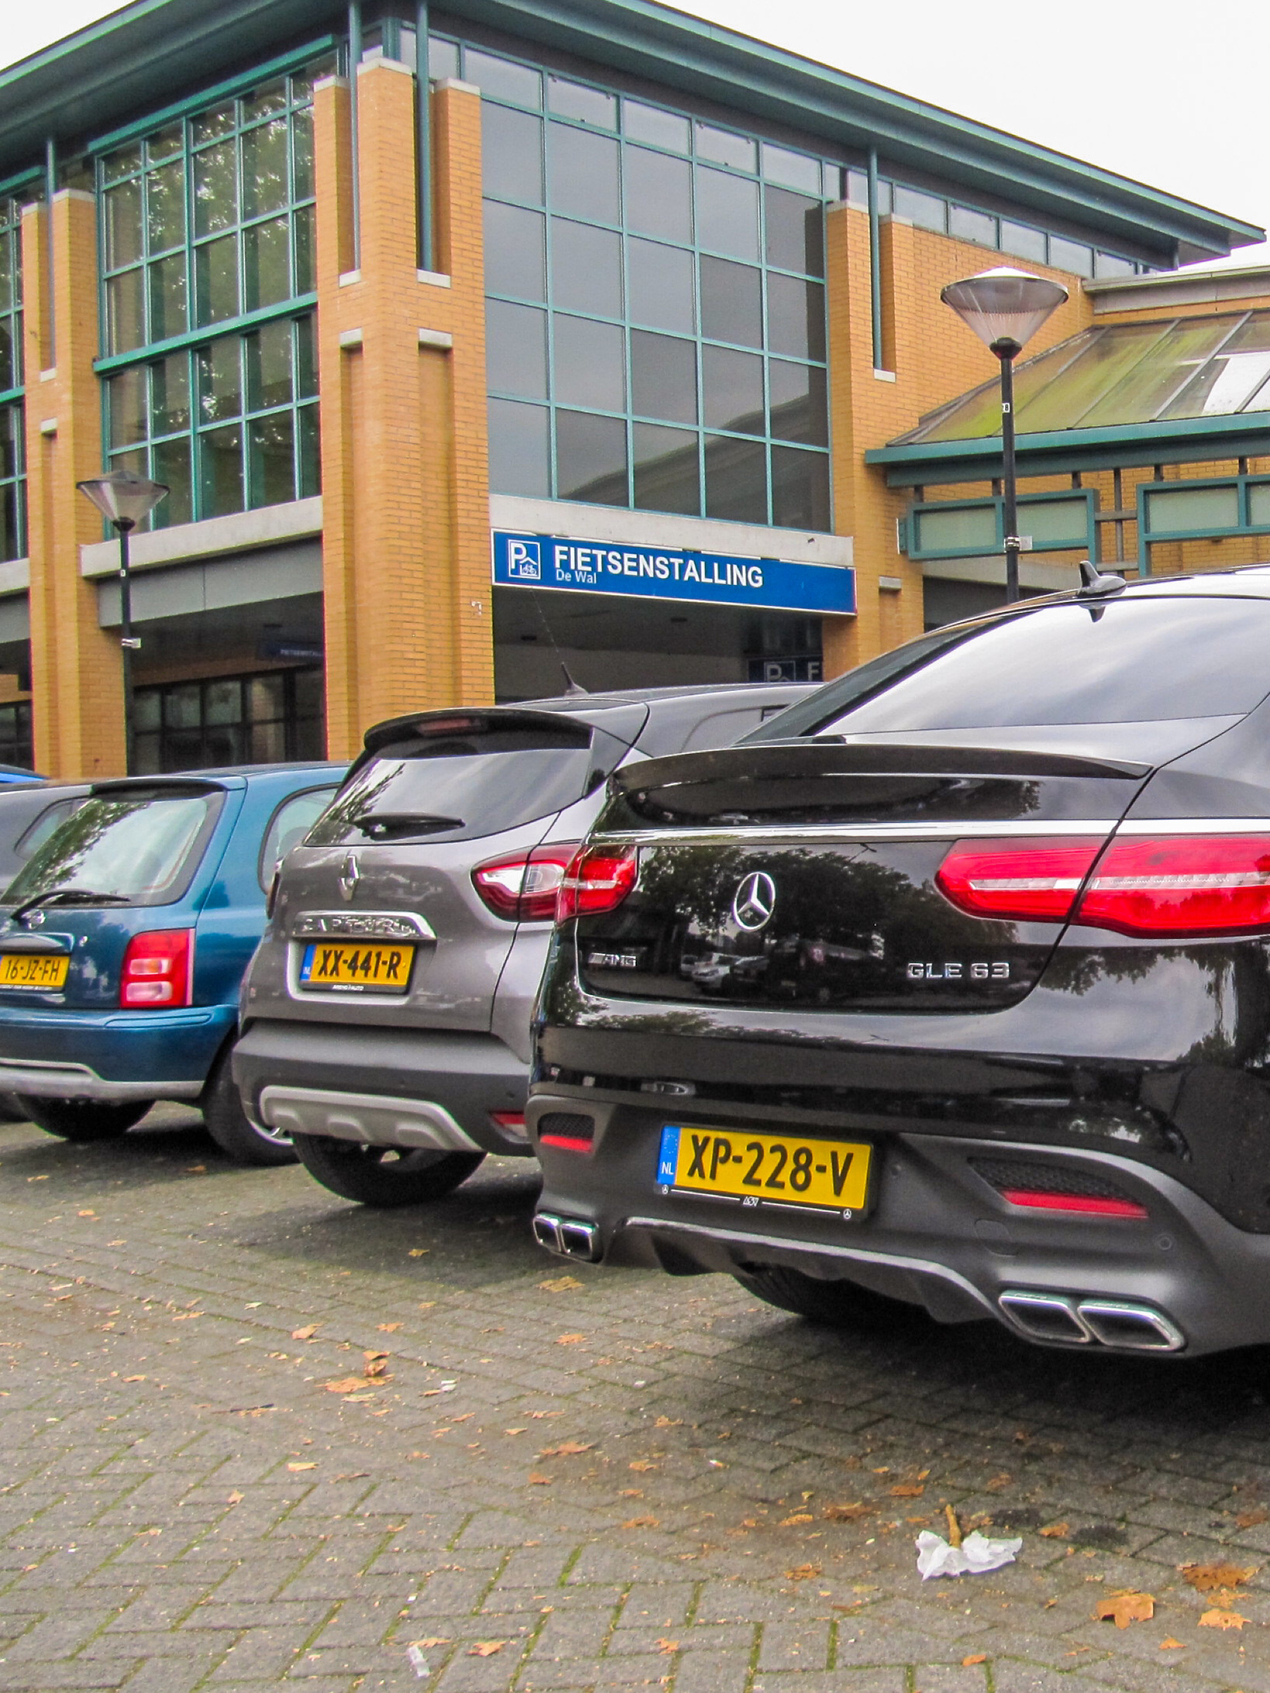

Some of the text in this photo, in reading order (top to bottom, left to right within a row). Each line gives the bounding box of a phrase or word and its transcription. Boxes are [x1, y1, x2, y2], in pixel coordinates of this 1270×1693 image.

[554, 545, 764, 588] FIETSENSTALLING
[556, 569, 597, 584] De Wal
[5, 959, 60, 981] 16-JZ-FH
[318, 949, 402, 979] XX-441-R
[907, 962, 1010, 979] GLE 63
[661, 1134, 854, 1197] NL XP-228-V
